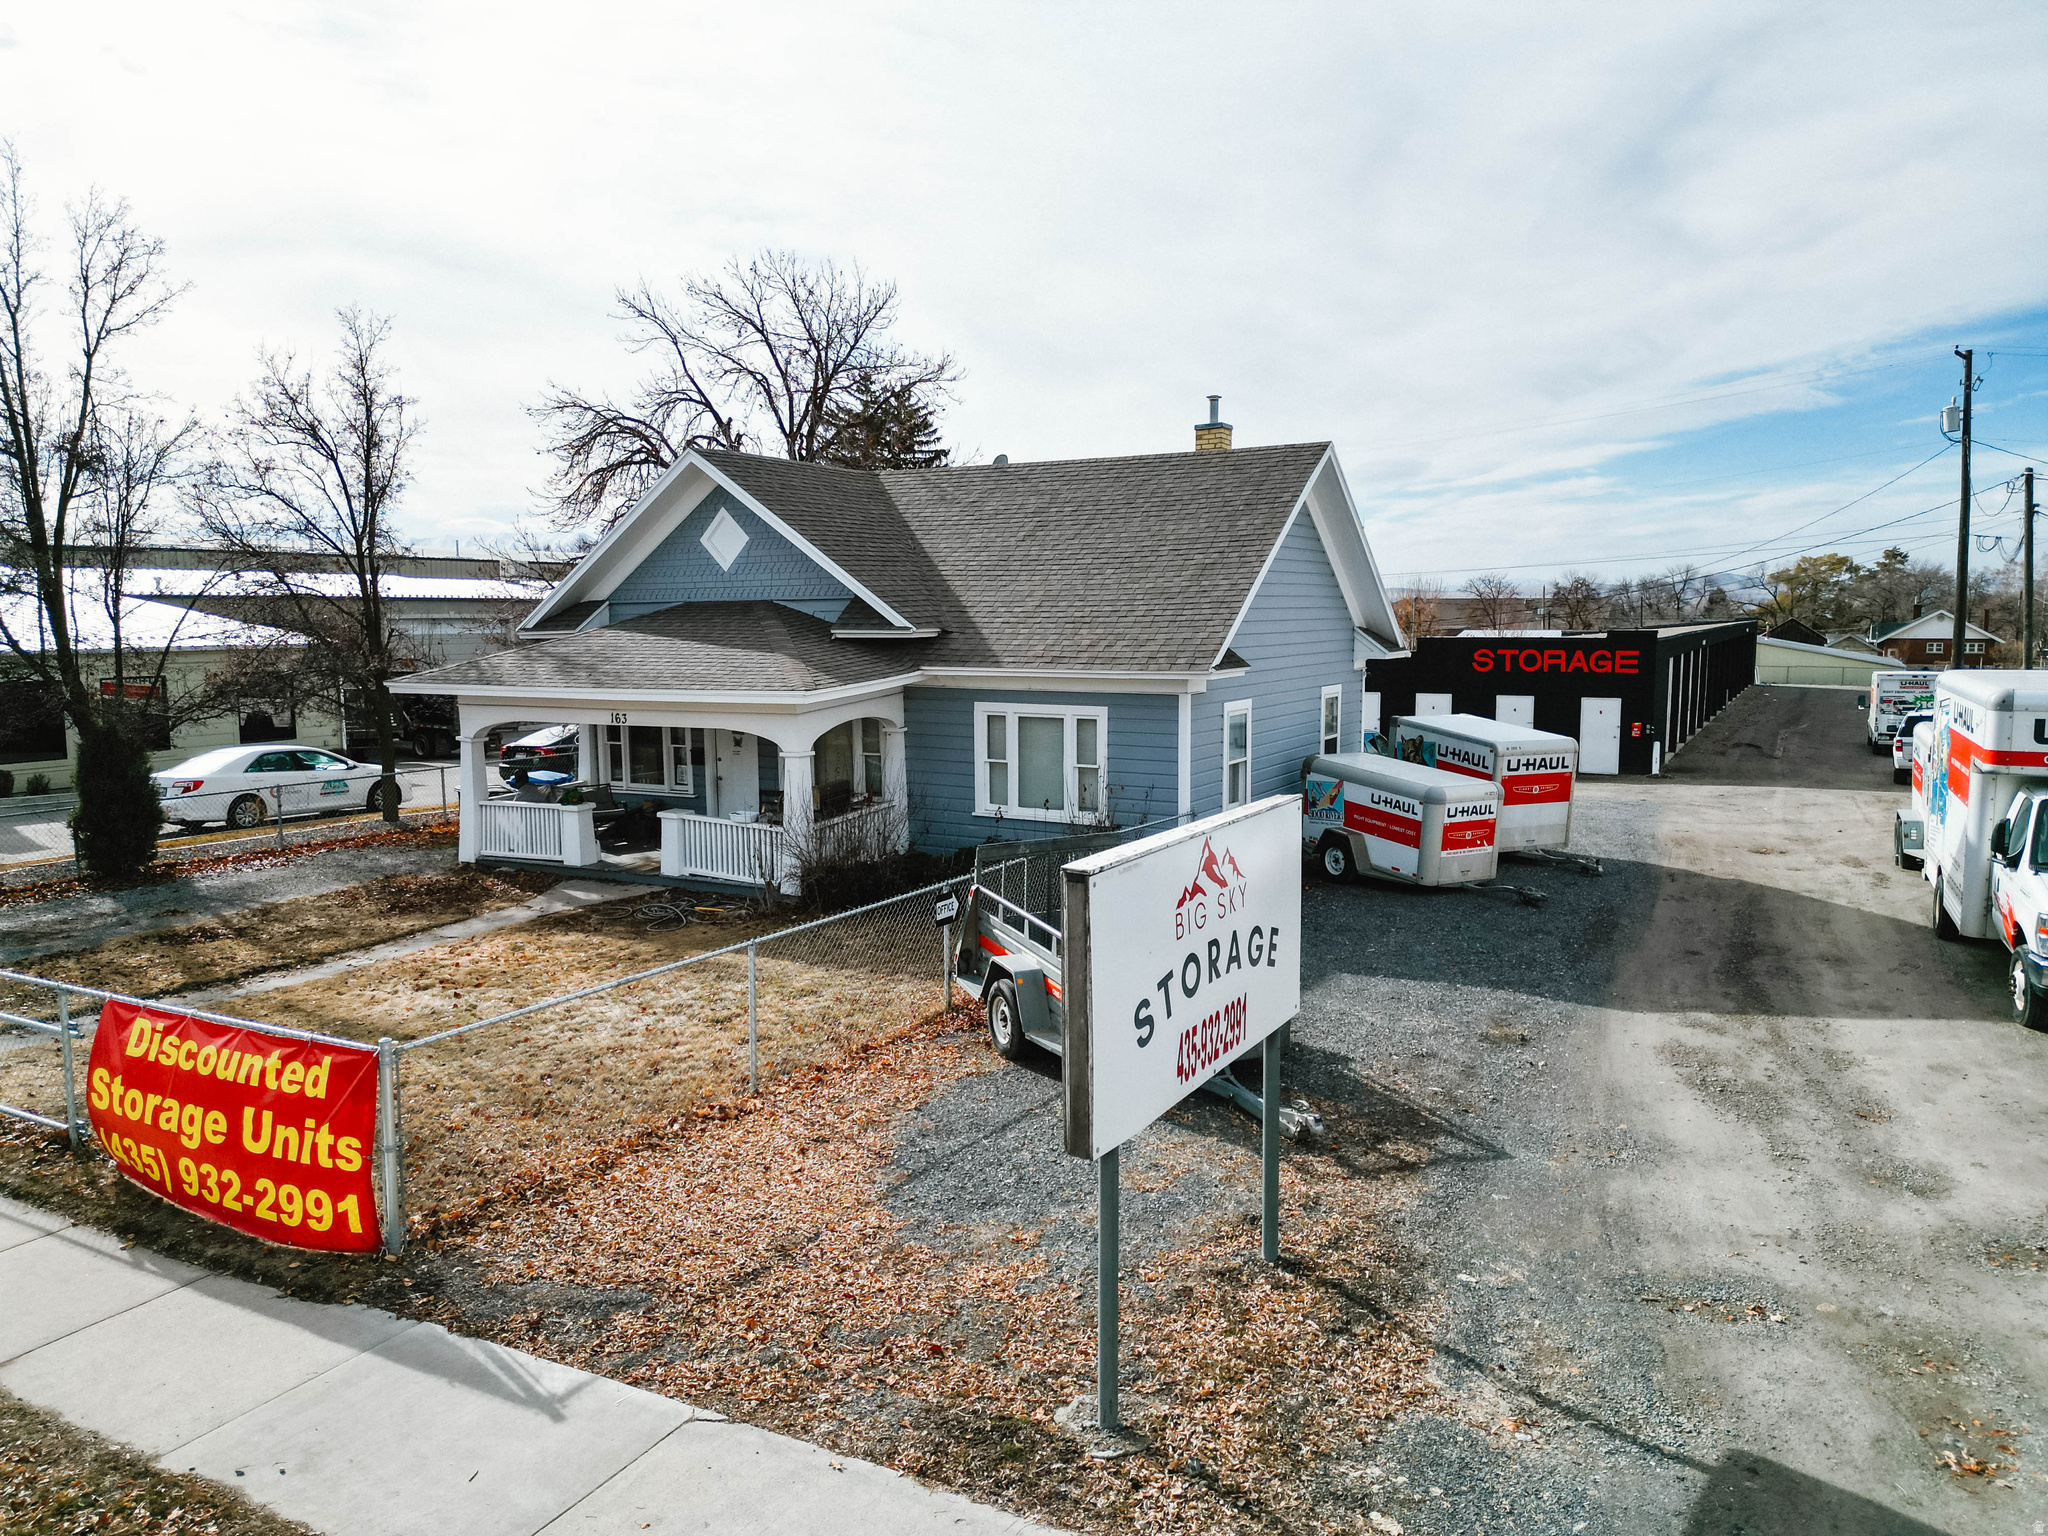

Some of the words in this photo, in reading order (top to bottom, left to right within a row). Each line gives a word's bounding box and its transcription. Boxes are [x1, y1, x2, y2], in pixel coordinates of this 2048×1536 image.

[1472, 649, 1640, 673] STORAGE
[610, 712, 627, 724] 163
[1953, 701, 1974, 734] U-HAUL
[1437, 743, 1489, 770] U-HAUL
[1506, 756, 1570, 772] U-HAUL
[1370, 792, 1419, 816] U-HAUL
[1446, 804, 1495, 819] U-HAUL
[1353, 813, 1365, 821] RIGHT
[1364, 817, 1387, 828] EQUIPMENT
[1389, 824, 1405, 833] LOWEST
[1405, 829, 1417, 837] COST
[937, 900, 955, 916] OFFICE
[1175, 902, 1207, 941] BIG
[1217, 882, 1247, 919] SKY
[1134, 925, 1279, 1048] STORAGE
[1176, 992, 1247, 1085] 435-932-2991
[126, 1016, 332, 1099] Discounted
[90, 1067, 228, 1149] Storage
[242, 1106, 363, 1172] Units
[178, 1156, 363, 1234] 932-2991
